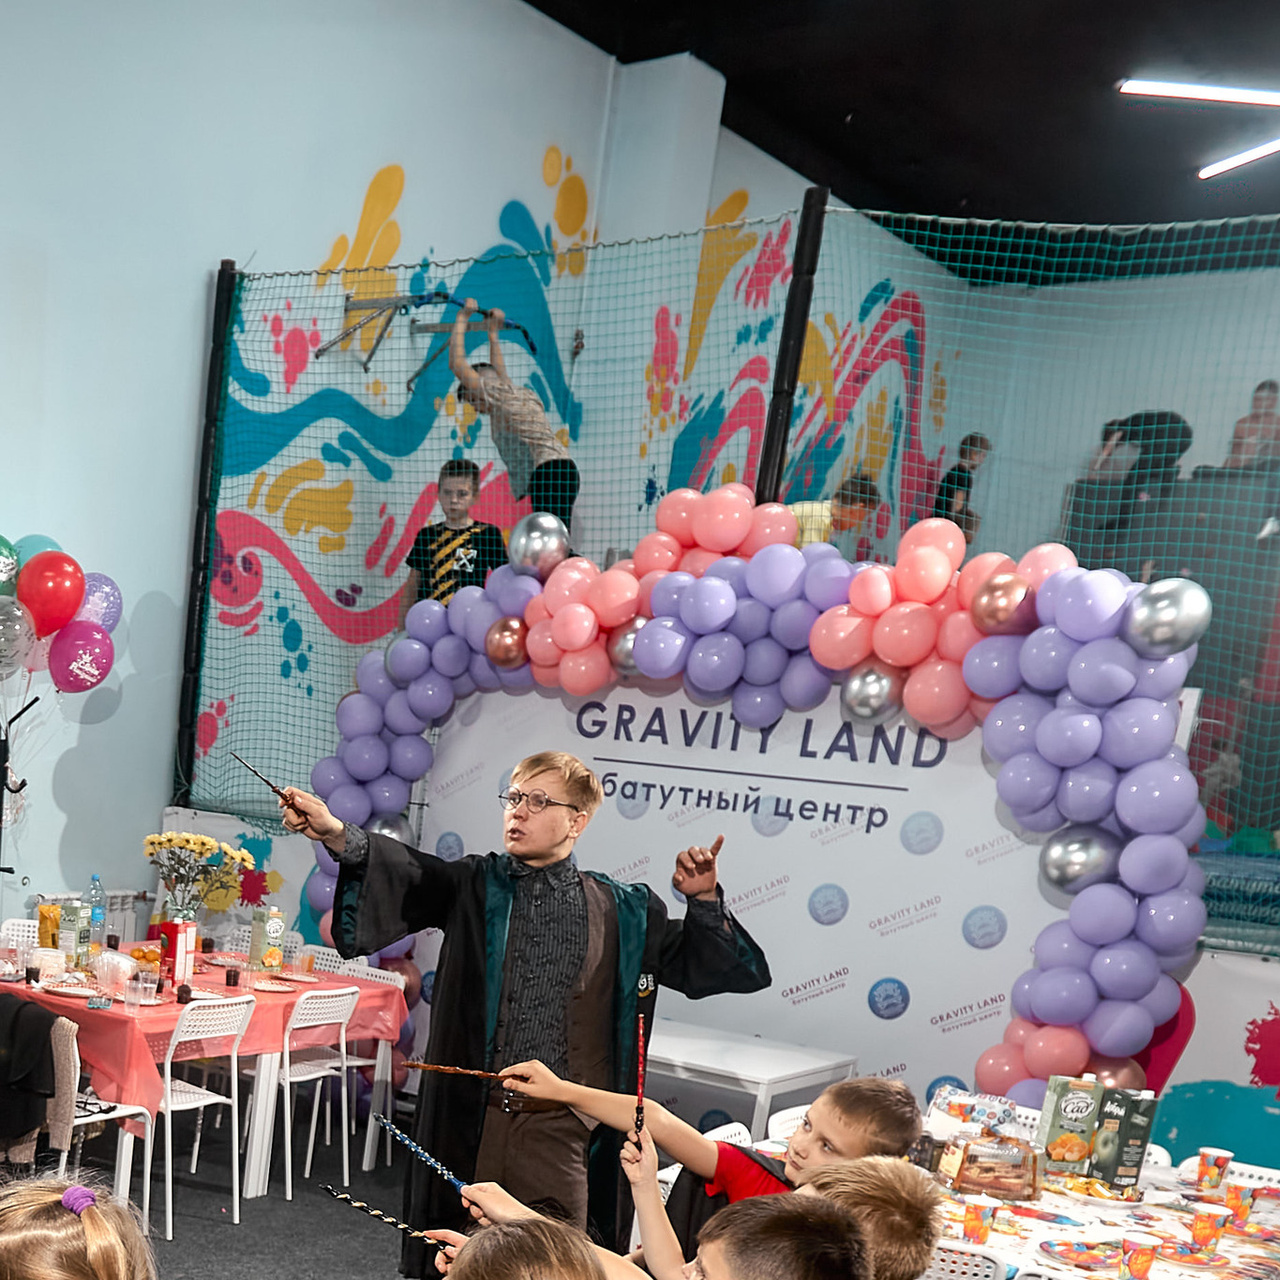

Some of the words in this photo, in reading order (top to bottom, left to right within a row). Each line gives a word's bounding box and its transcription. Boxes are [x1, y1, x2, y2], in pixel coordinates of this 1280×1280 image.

[799, 716, 949, 769] LAND
[601, 772, 762, 815] батутный
[773, 798, 889, 834] центр
[764, 874, 791, 891] LAND
[869, 906, 911, 930] GRAVITY
[914, 895, 942, 912] LAND
[781, 977, 822, 998] GRAVITY
[823, 966, 850, 983] LAND
[930, 1003, 975, 1026] GRAVITY
[976, 993, 1006, 1010] LAND
[880, 1063, 907, 1078] LAND
